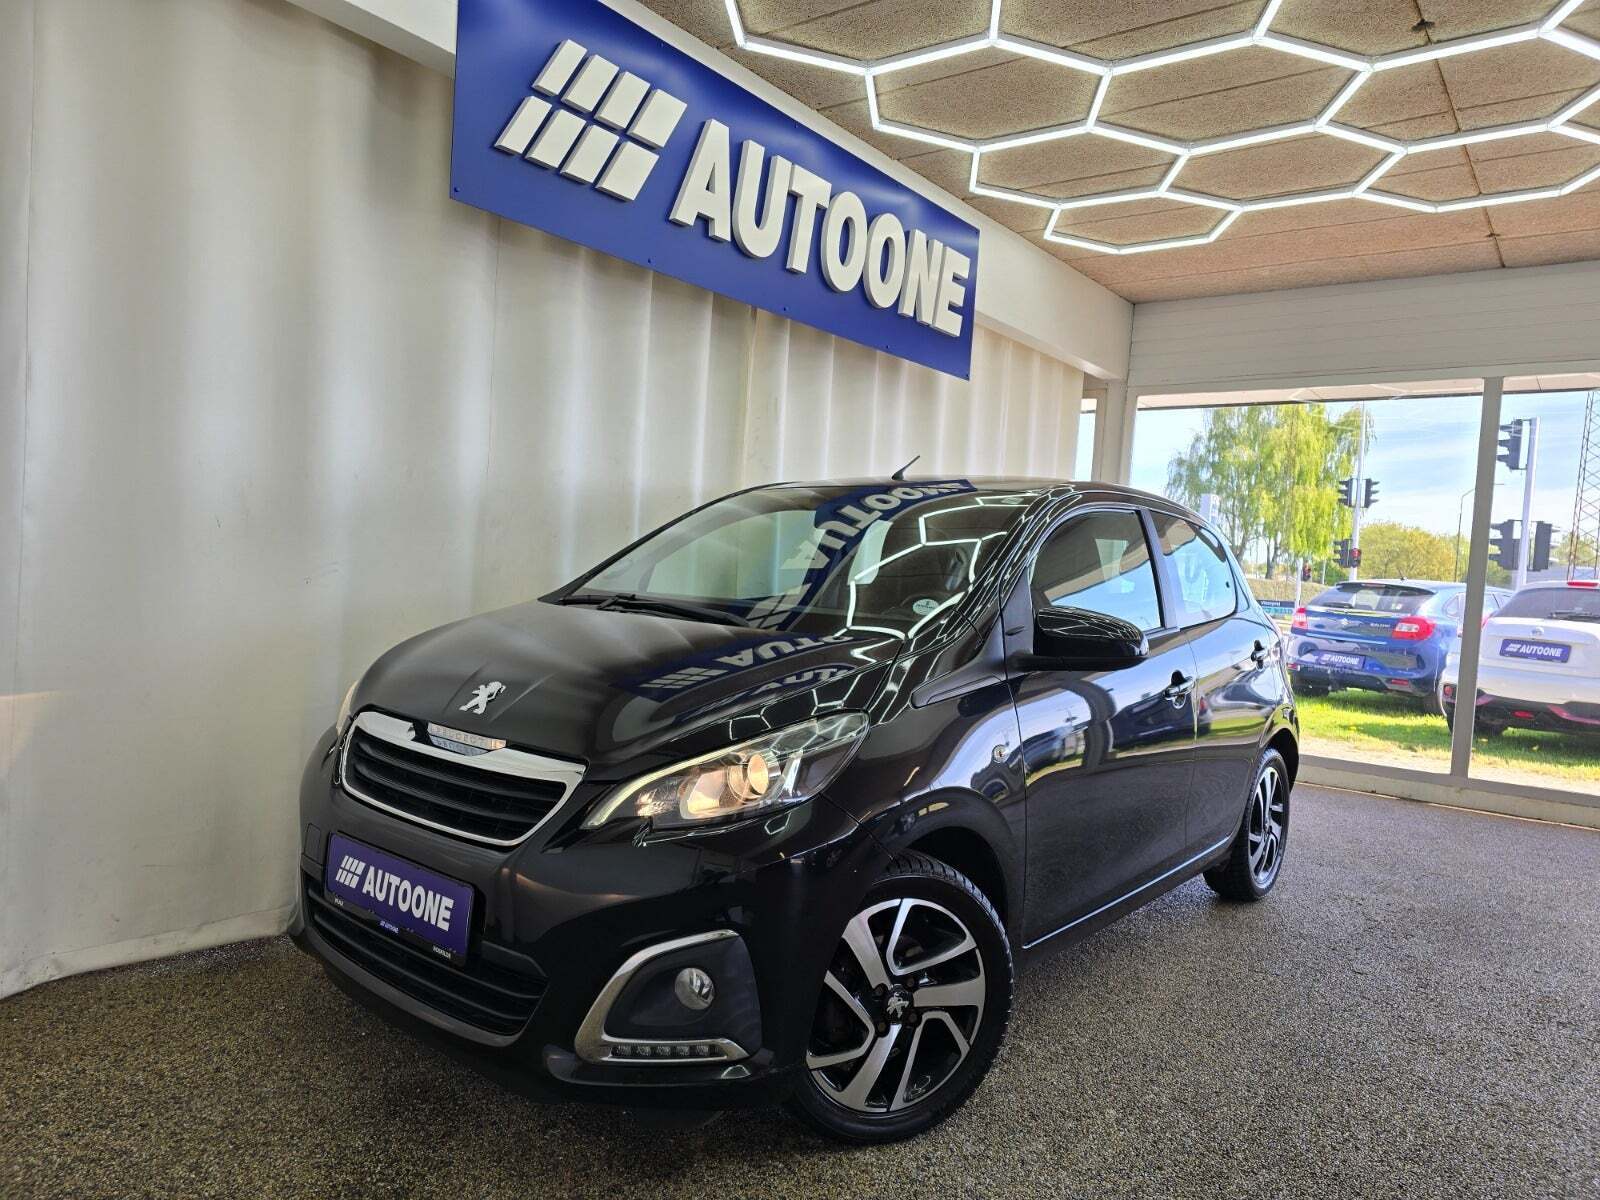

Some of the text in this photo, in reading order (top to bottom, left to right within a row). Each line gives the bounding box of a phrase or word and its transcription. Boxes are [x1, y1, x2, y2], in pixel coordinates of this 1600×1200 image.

[669, 118, 971, 337] AUTOONE
[1330, 655, 1360, 665] AUTOONE
[1519, 644, 1563, 657] AUTOONE
[362, 865, 454, 932] AUTOONE
